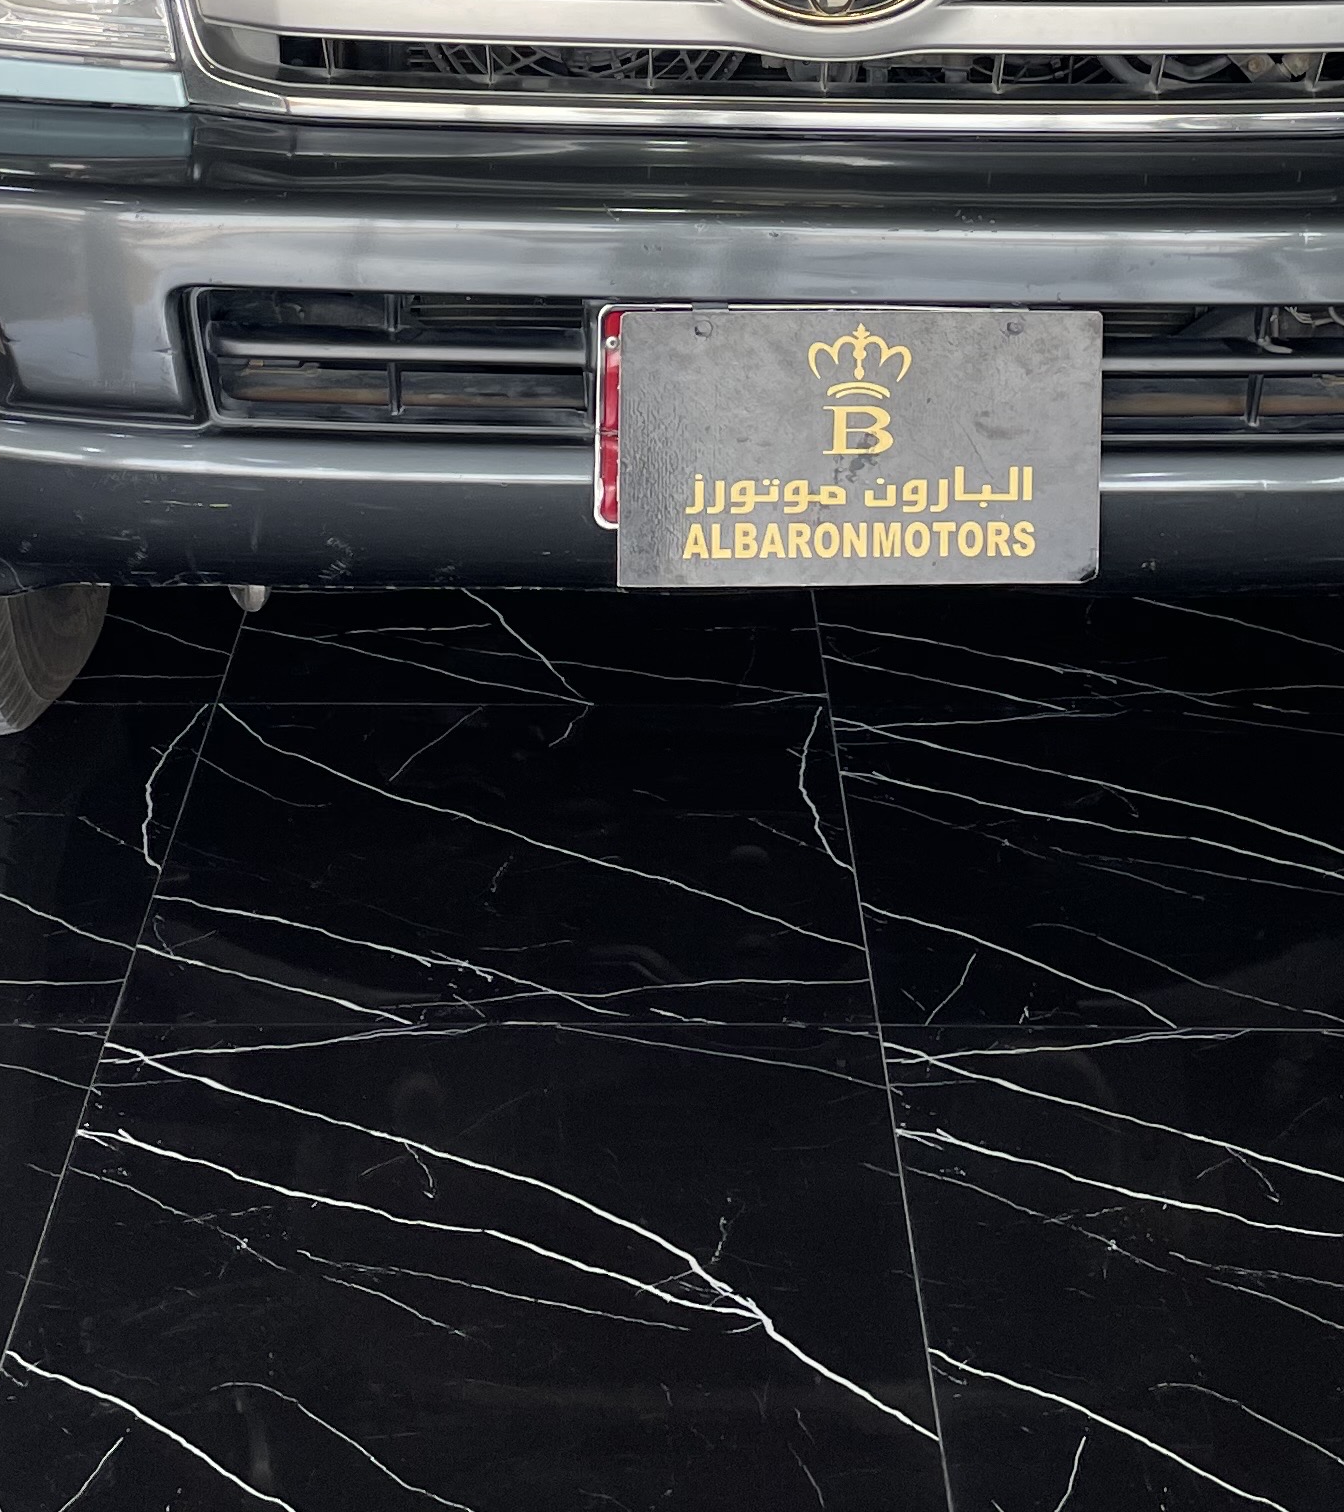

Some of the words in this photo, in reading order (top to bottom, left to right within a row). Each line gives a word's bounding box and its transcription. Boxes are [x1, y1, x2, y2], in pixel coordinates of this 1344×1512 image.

[822, 405, 895, 456] B
[685, 474, 847, 514] موتورز
[864, 466, 1034, 514] البارون
